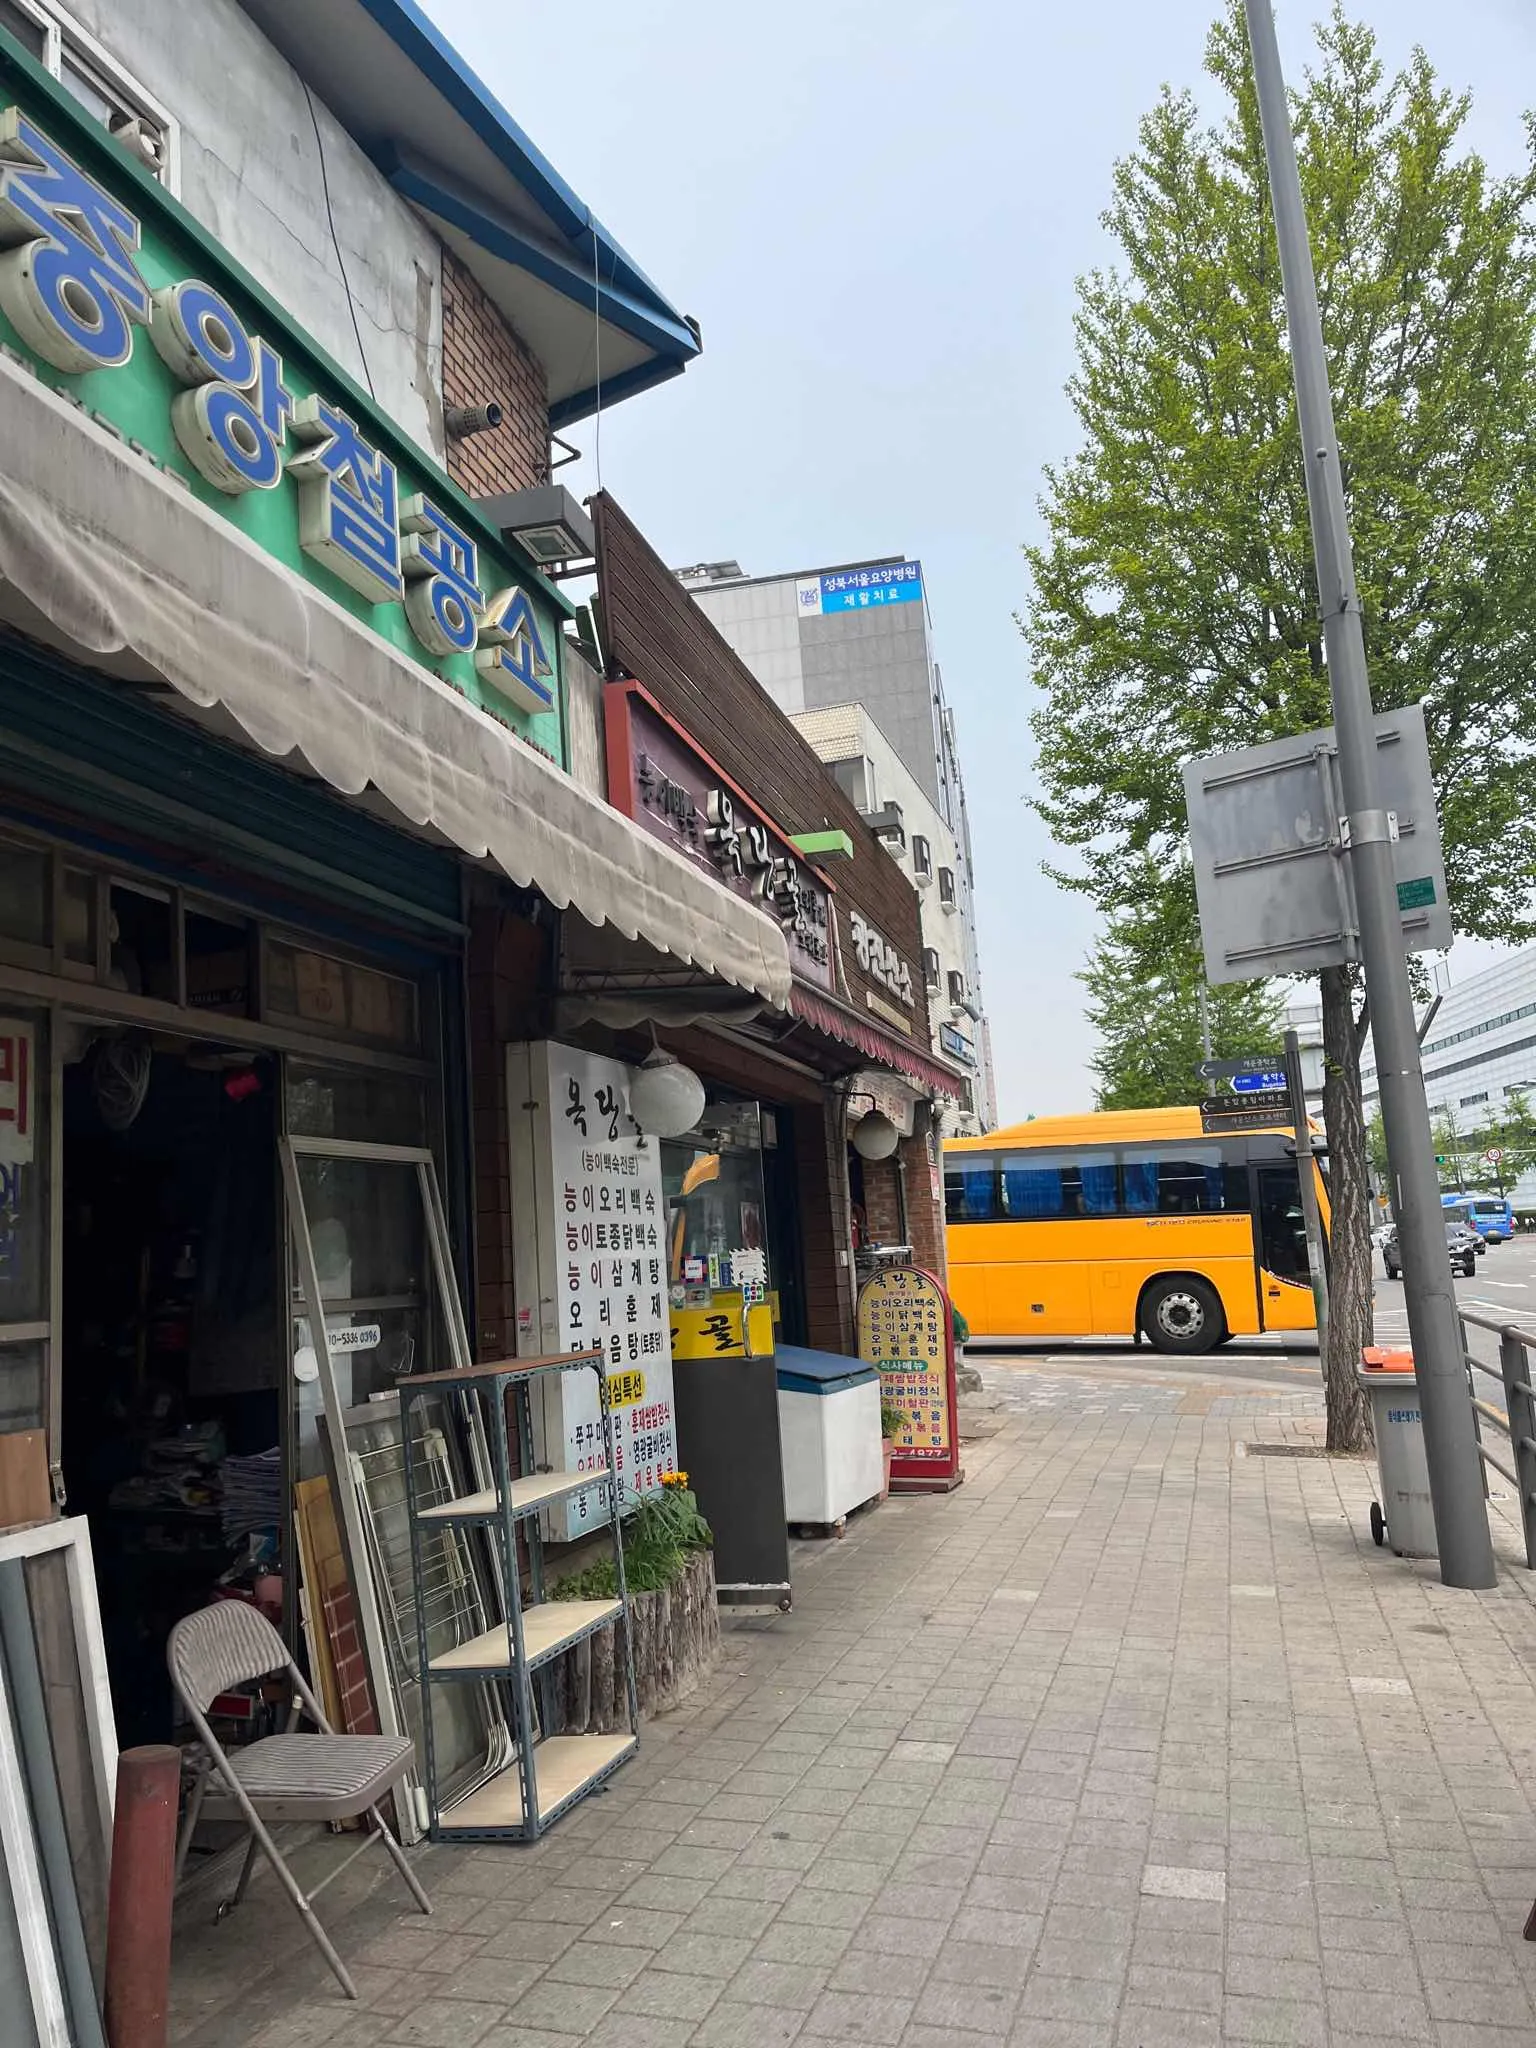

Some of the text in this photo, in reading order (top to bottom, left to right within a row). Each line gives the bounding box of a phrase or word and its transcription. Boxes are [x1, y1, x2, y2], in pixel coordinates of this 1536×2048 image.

[0, 106, 556, 713] 중앙철공소
[824, 565, 916, 591] 성북서울요양병원
[843, 588, 899, 607] 재활치료
[582, 1149, 639, 1177] (능이백숙전문)
[1489, 1151, 1500, 1160] 50
[563, 1182, 656, 1216] 능이오리백숙
[565, 1221, 658, 1252] 능이토종닭백숙
[567, 1258, 660, 1292] 능이삼계탕
[569, 1293, 662, 1330] 오리훈제
[870, 1298, 937, 1309] 능이오리백숙
[870, 1310, 937, 1320] 능이닭백숙
[360, 1330, 378, 1343] 0396
[871, 1322, 937, 1333] 능이삼계탕
[871, 1334, 938, 1344] 오리훈제
[880, 1360, 925, 1371] 식사메뉴
[881, 1373, 939, 1384] 제쌈밥정식
[631, 1401, 671, 1434] 훈제쌈밥정식
[575, 1413, 622, 1453] 쭈꾸미판
[633, 1429, 672, 1465] 영광굴비정식
